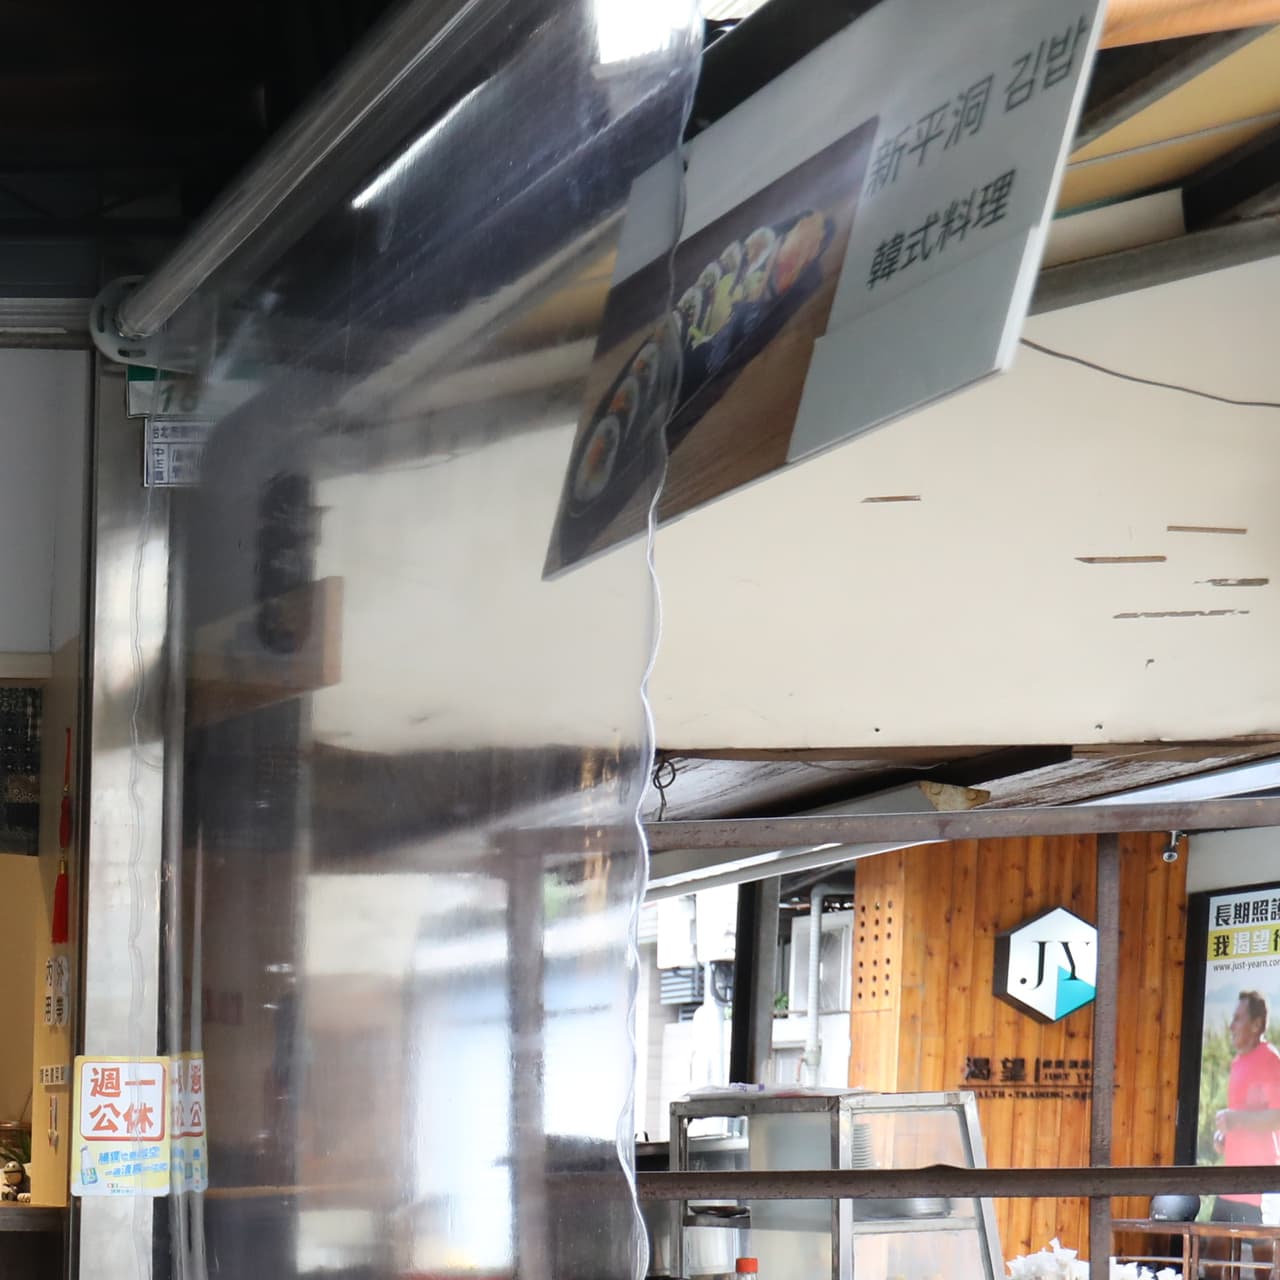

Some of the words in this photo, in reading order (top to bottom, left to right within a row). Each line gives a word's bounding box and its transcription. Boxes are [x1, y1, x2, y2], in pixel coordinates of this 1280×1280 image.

[866, 73, 995, 197] 新平洞
[1005, 14, 1088, 112] 김밥
[868, 169, 1016, 288] 韓式料理
[89, 1103, 154, 1133] 公休
[90, 1067, 156, 1098] 週一
